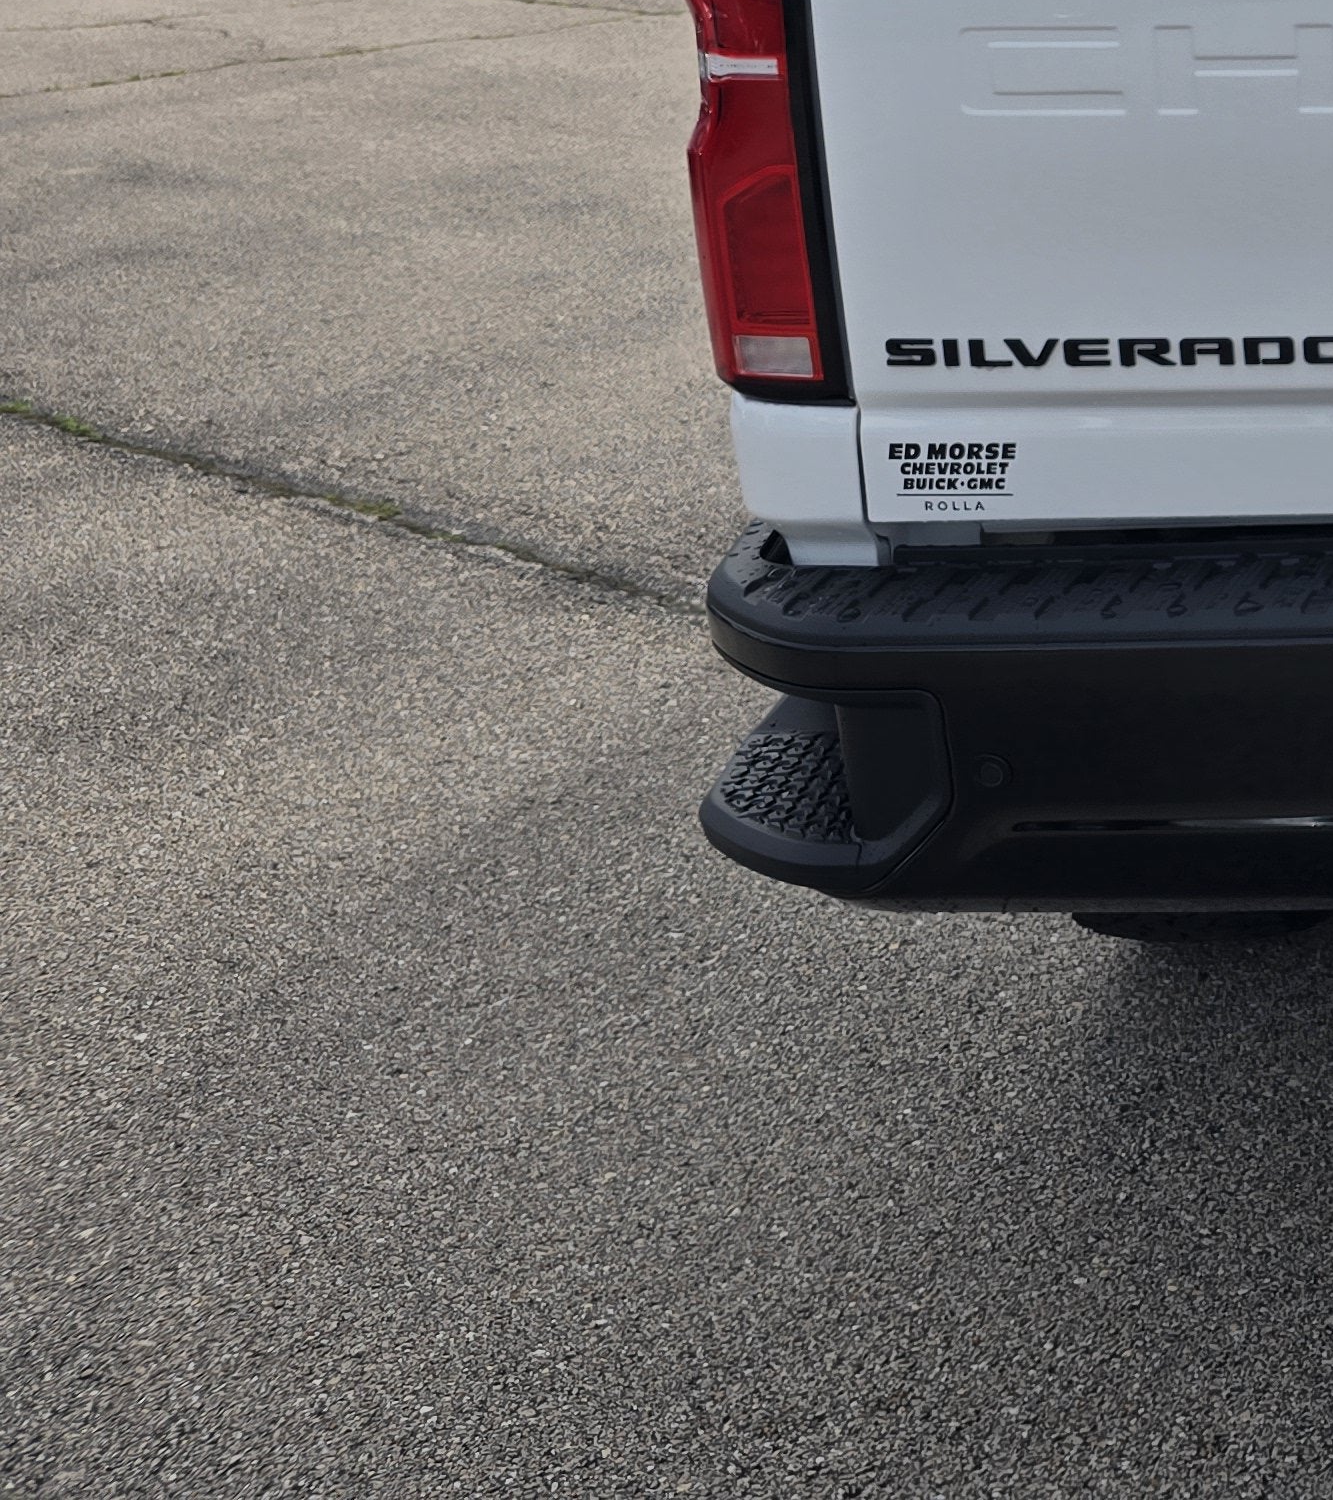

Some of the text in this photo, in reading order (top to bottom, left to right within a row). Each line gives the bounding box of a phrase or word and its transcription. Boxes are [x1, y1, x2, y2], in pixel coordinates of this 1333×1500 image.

[888, 443, 1017, 460] ED MORSE
[900, 462, 1010, 475] CHEVROLET
[925, 501, 985, 511] ROLLA
